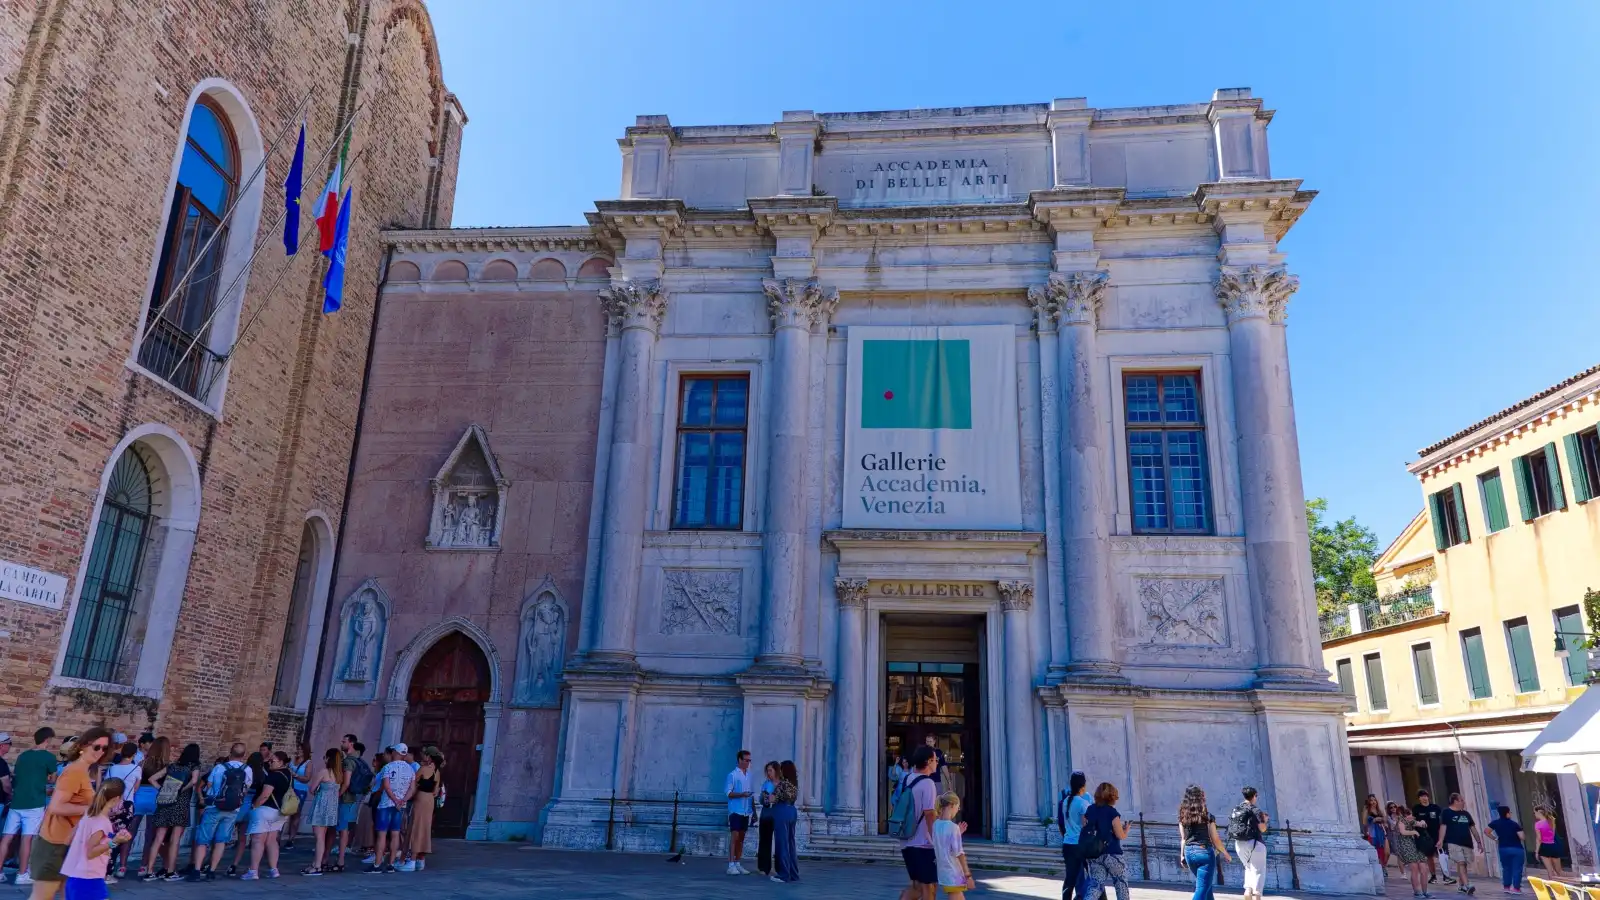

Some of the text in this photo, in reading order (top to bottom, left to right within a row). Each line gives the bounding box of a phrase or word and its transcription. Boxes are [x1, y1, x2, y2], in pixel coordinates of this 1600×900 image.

[874, 158, 989, 172] ACCADEMIA
[856, 174, 1008, 189] DI BELLE ARTI
[861, 451, 946, 471] Gallerie
[859, 474, 987, 495] Accademia,
[860, 496, 946, 514] Venezia
[3, 567, 47, 586] CAMPO
[880, 583, 984, 597] GALLERIE
